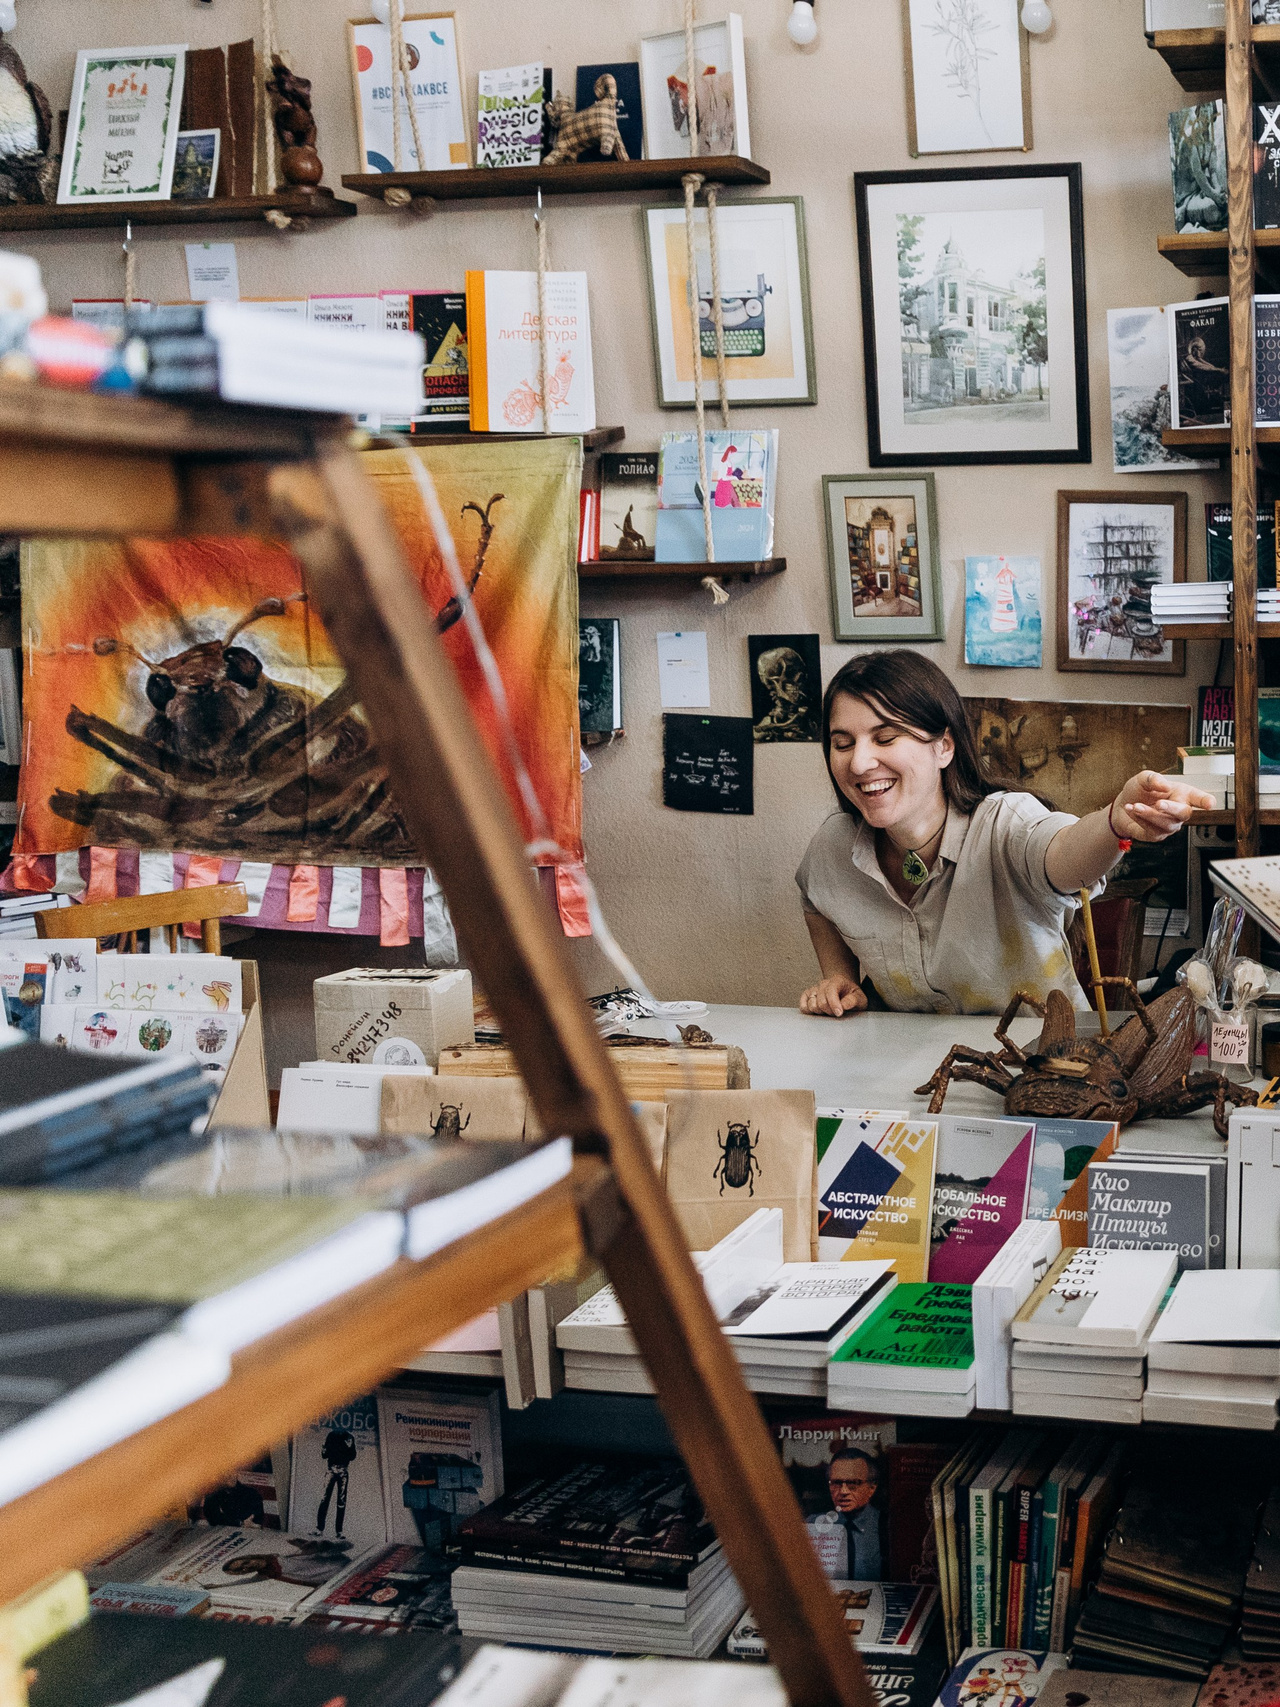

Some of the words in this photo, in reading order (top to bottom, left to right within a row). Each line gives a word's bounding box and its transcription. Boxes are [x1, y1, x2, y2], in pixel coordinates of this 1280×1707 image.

[483, 109, 539, 129] MUSIC
[482, 131, 522, 149] MAG
[314, 313, 353, 322] КНИЖКИ
[521, 312, 577, 326] Деская
[1189, 317, 1215, 328] ФАКАП
[619, 464, 656, 475] ГОЛИАФ
[1091, 1171, 1130, 1192] Кио
[827, 1191, 917, 1208] АБСТРАКТНОЕ
[1091, 1193, 1172, 1218] Маклир
[833, 1208, 909, 1224] ИСКУССТВО
[1091, 1213, 1168, 1236] Птицы
[1091, 1234, 1203, 1258] Искусство
[787, 1284, 864, 1292] ИСТОРИЯ
[794, 1277, 870, 1286] КРАТКАЯ
[899, 1322, 967, 1336] работа
[884, 1342, 918, 1353] Ad
[851, 1346, 959, 1368] Marginem
[409, 1427, 471, 1441] корпорации
[778, 1424, 834, 1444] Ларри
[840, 1426, 880, 1441] Кинг
[1018, 1490, 1030, 1520] SUPER
[974, 1494, 985, 1556] кулинария
